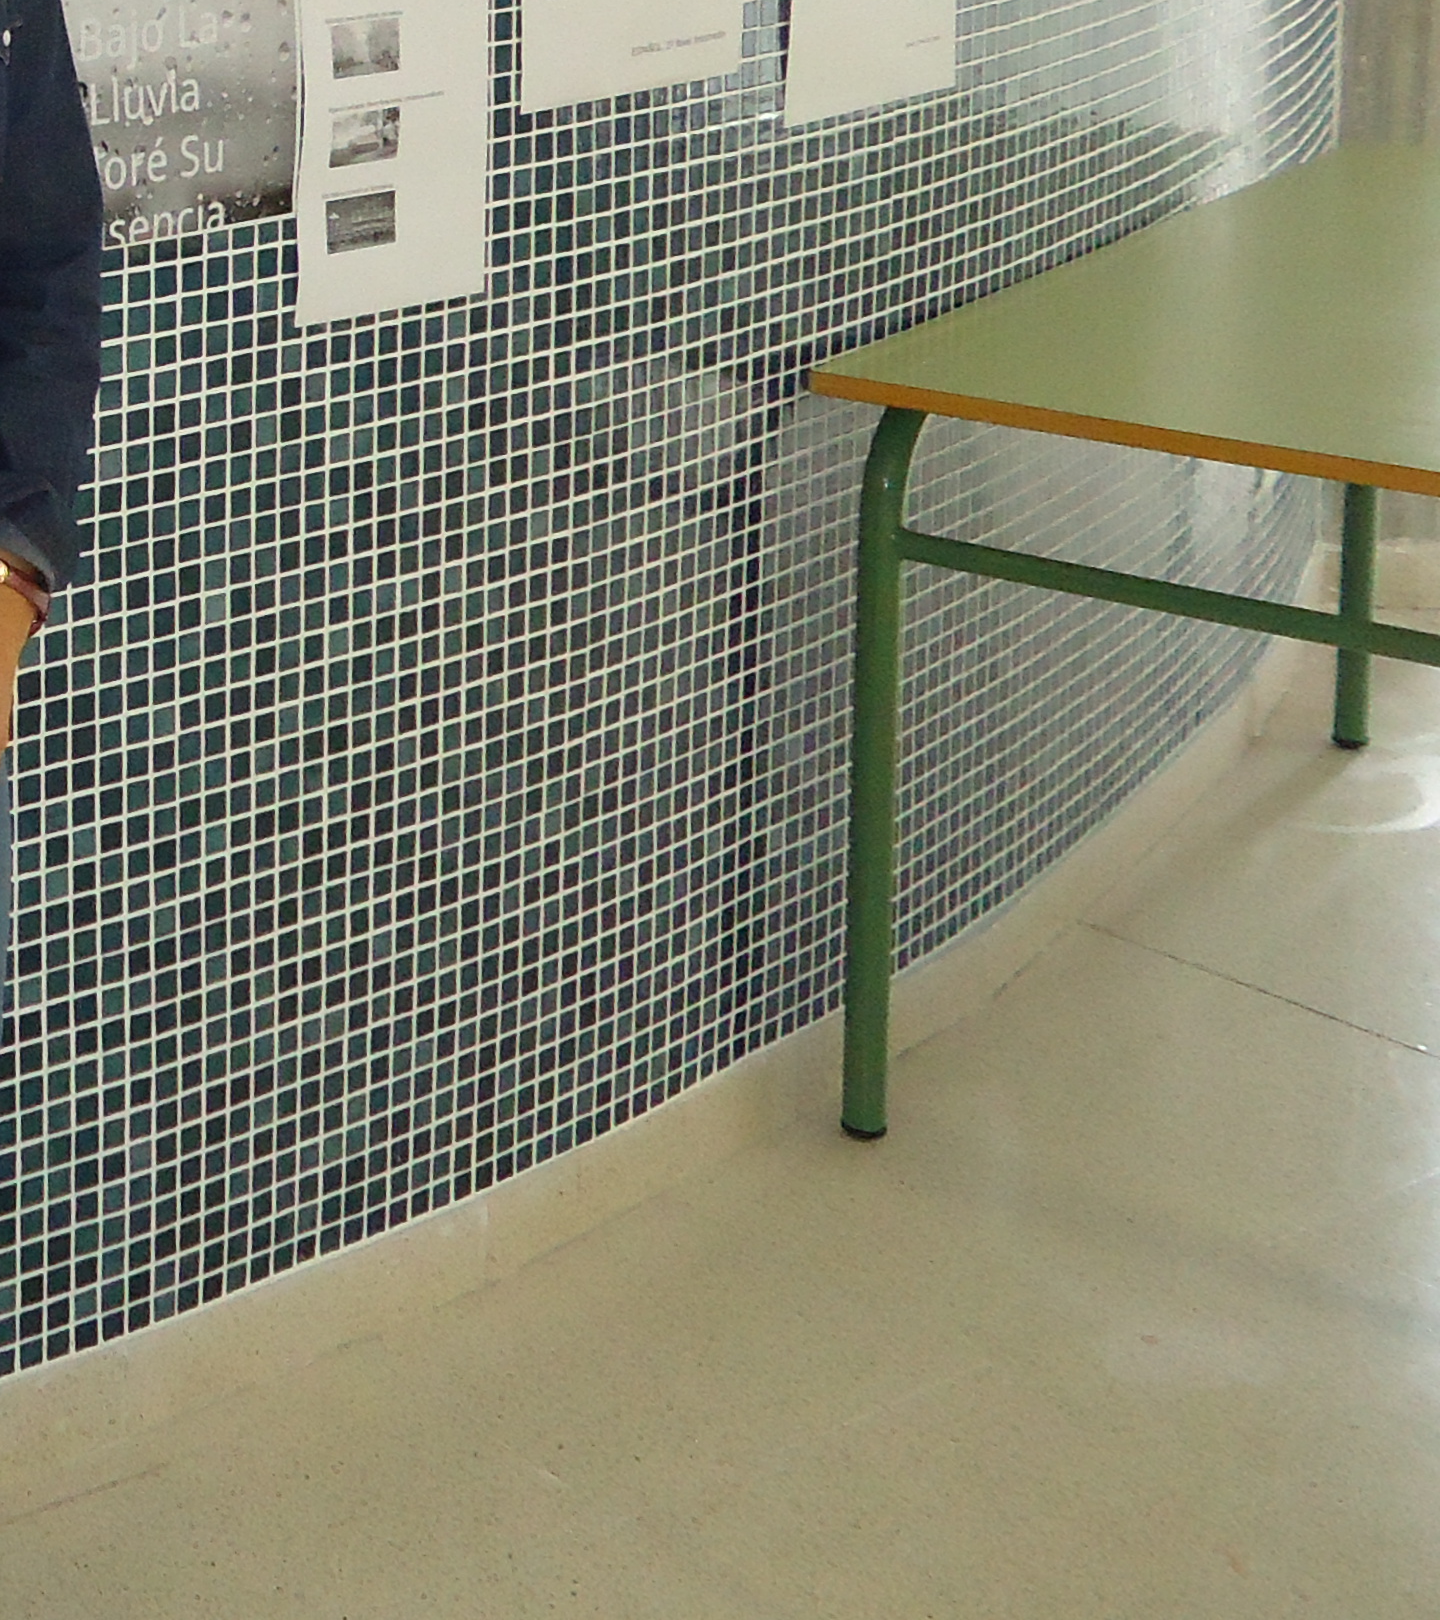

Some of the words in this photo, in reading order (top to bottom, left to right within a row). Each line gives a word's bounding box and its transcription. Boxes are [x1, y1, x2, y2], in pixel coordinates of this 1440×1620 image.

[178, 6, 218, 48] La
[179, 135, 225, 178] Su
[106, 193, 225, 246] sencia
